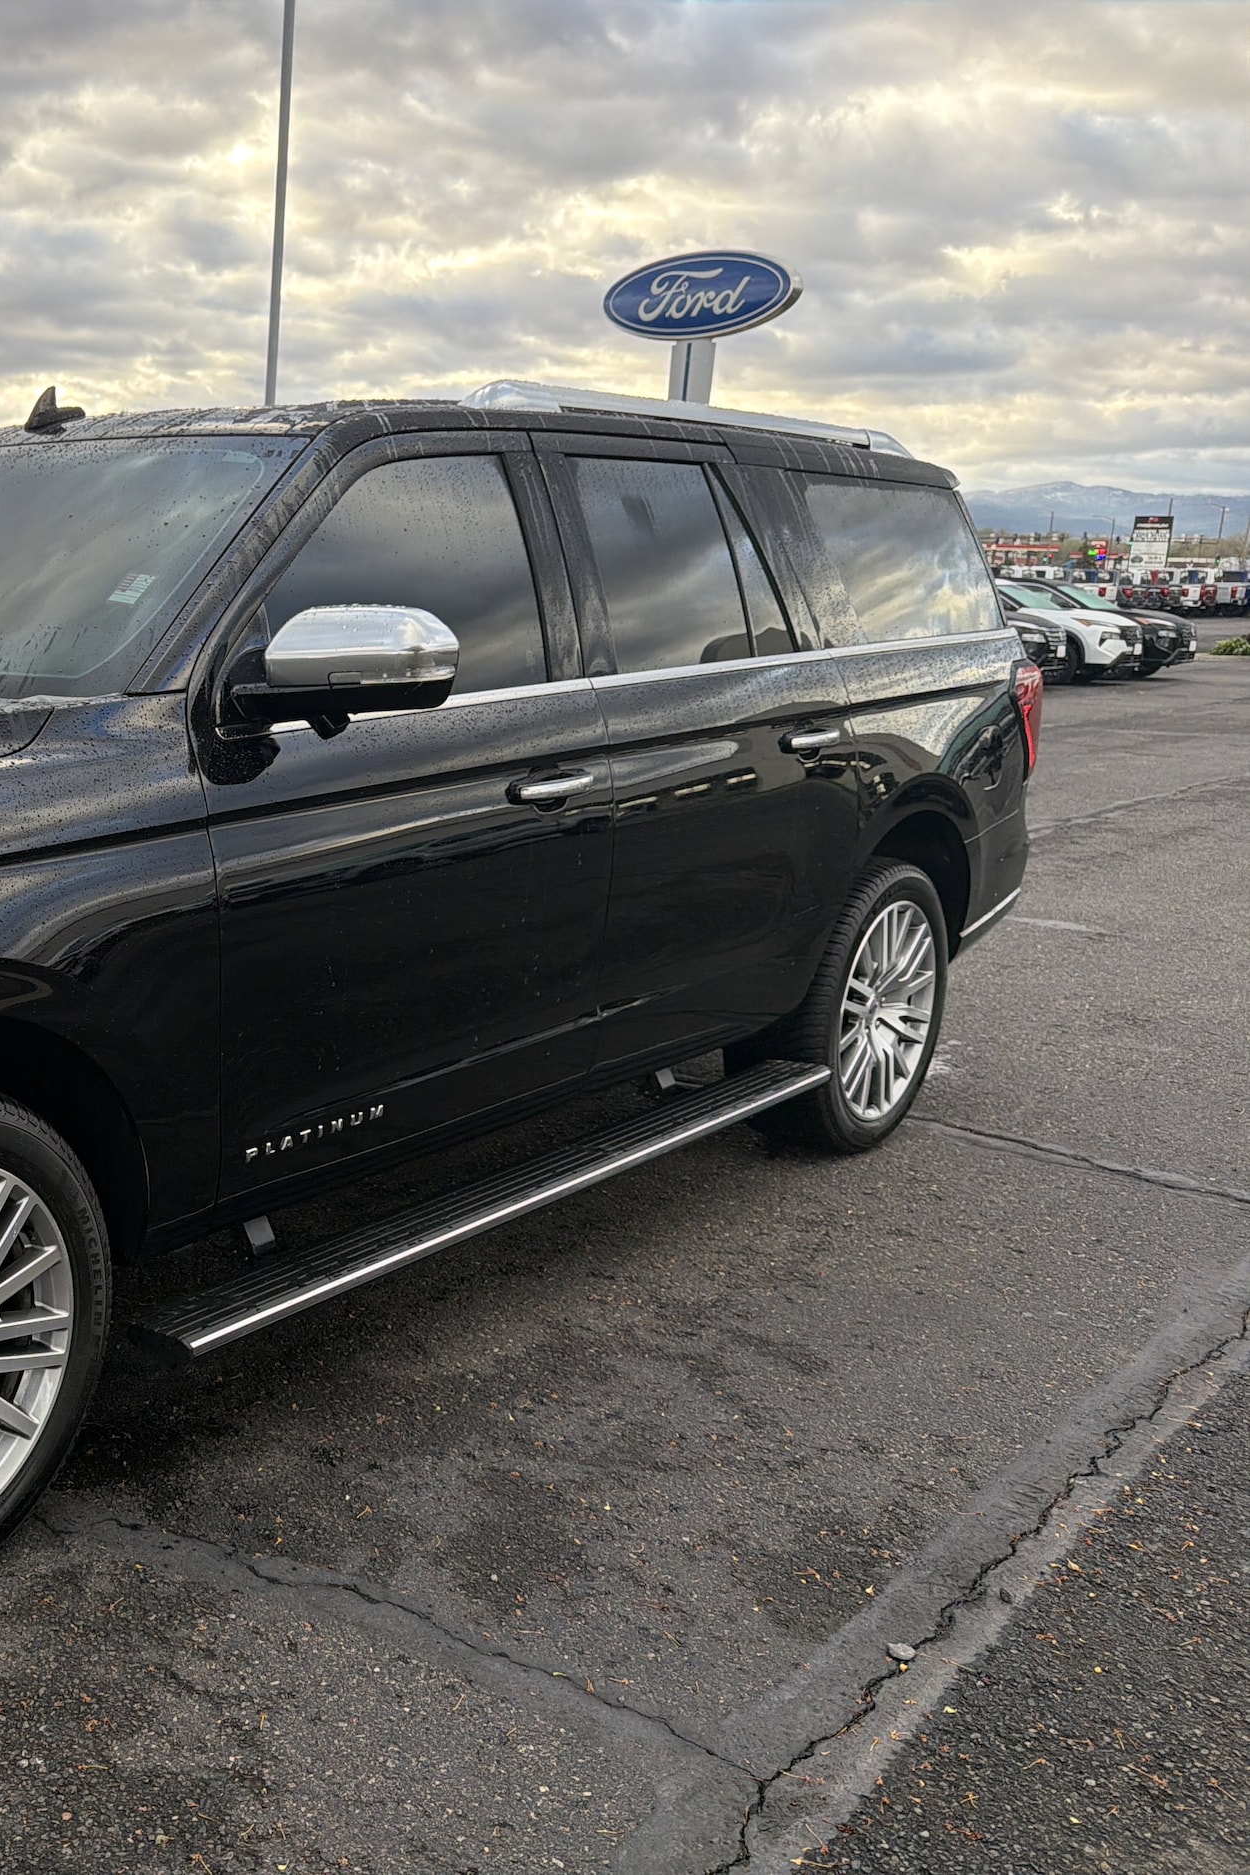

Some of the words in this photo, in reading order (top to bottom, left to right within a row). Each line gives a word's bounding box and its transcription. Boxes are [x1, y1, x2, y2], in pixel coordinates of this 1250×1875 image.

[638, 267, 750, 322] Ford
[245, 1104, 384, 1163] PLATINUM
[77, 1206, 103, 1326] MICHELIN
